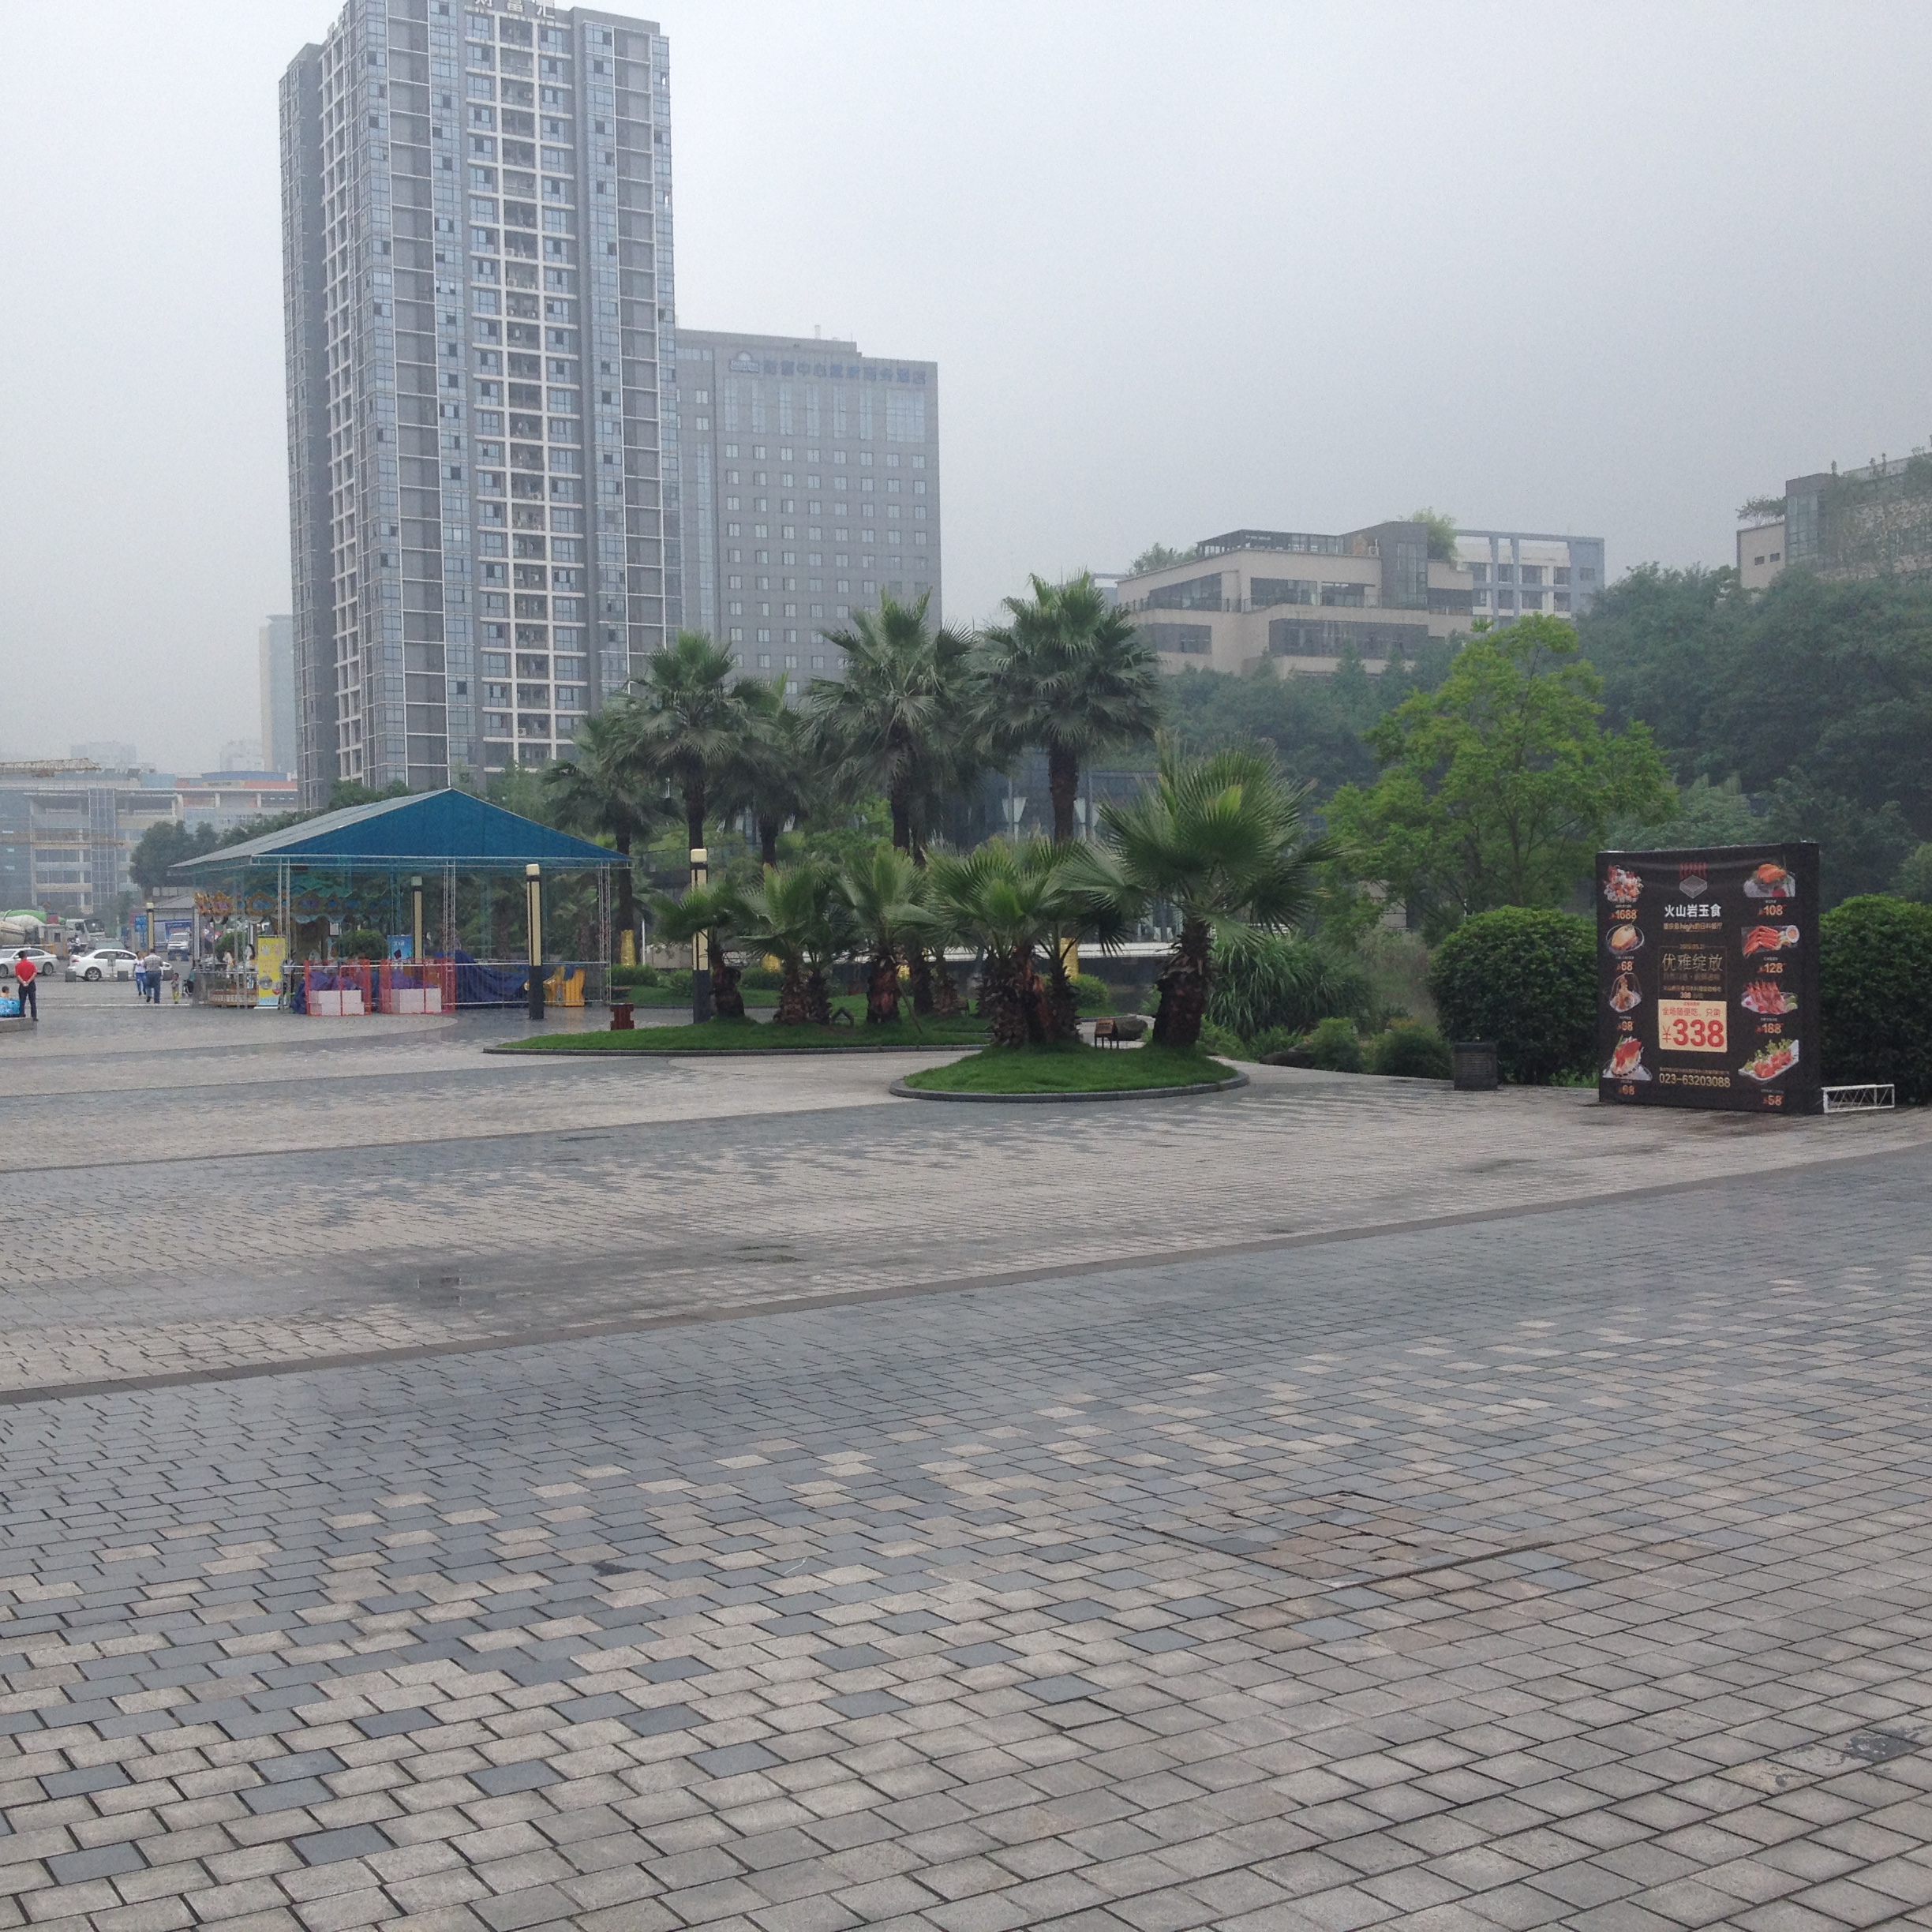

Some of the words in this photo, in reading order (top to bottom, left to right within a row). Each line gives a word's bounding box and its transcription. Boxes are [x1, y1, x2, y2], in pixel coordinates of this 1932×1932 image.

[1664, 904, 1721, 917] 火山岩玉食
[1661, 953, 1723, 972] 优雅绽放
[1659, 1073, 1731, 1088] 023-63203088
